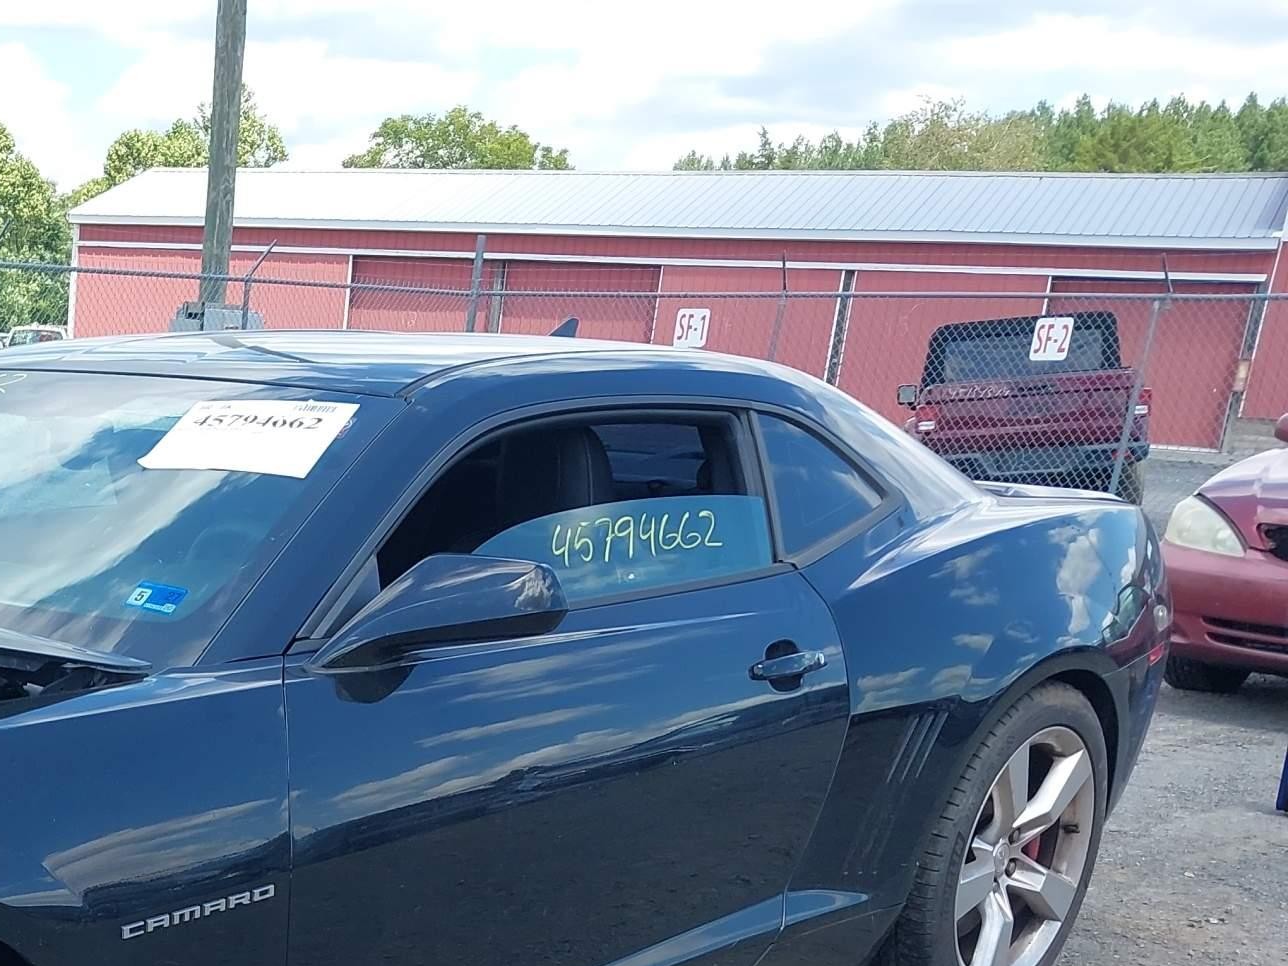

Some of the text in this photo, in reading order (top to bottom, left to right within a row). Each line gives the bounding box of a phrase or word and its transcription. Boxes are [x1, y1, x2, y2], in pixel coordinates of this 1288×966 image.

[676, 313, 707, 341] SF-1
[1033, 323, 1069, 354] SF-2
[551, 510, 723, 567] 45794662
[134, 590, 149, 602] 5
[121, 884, 275, 940] CAMARO
